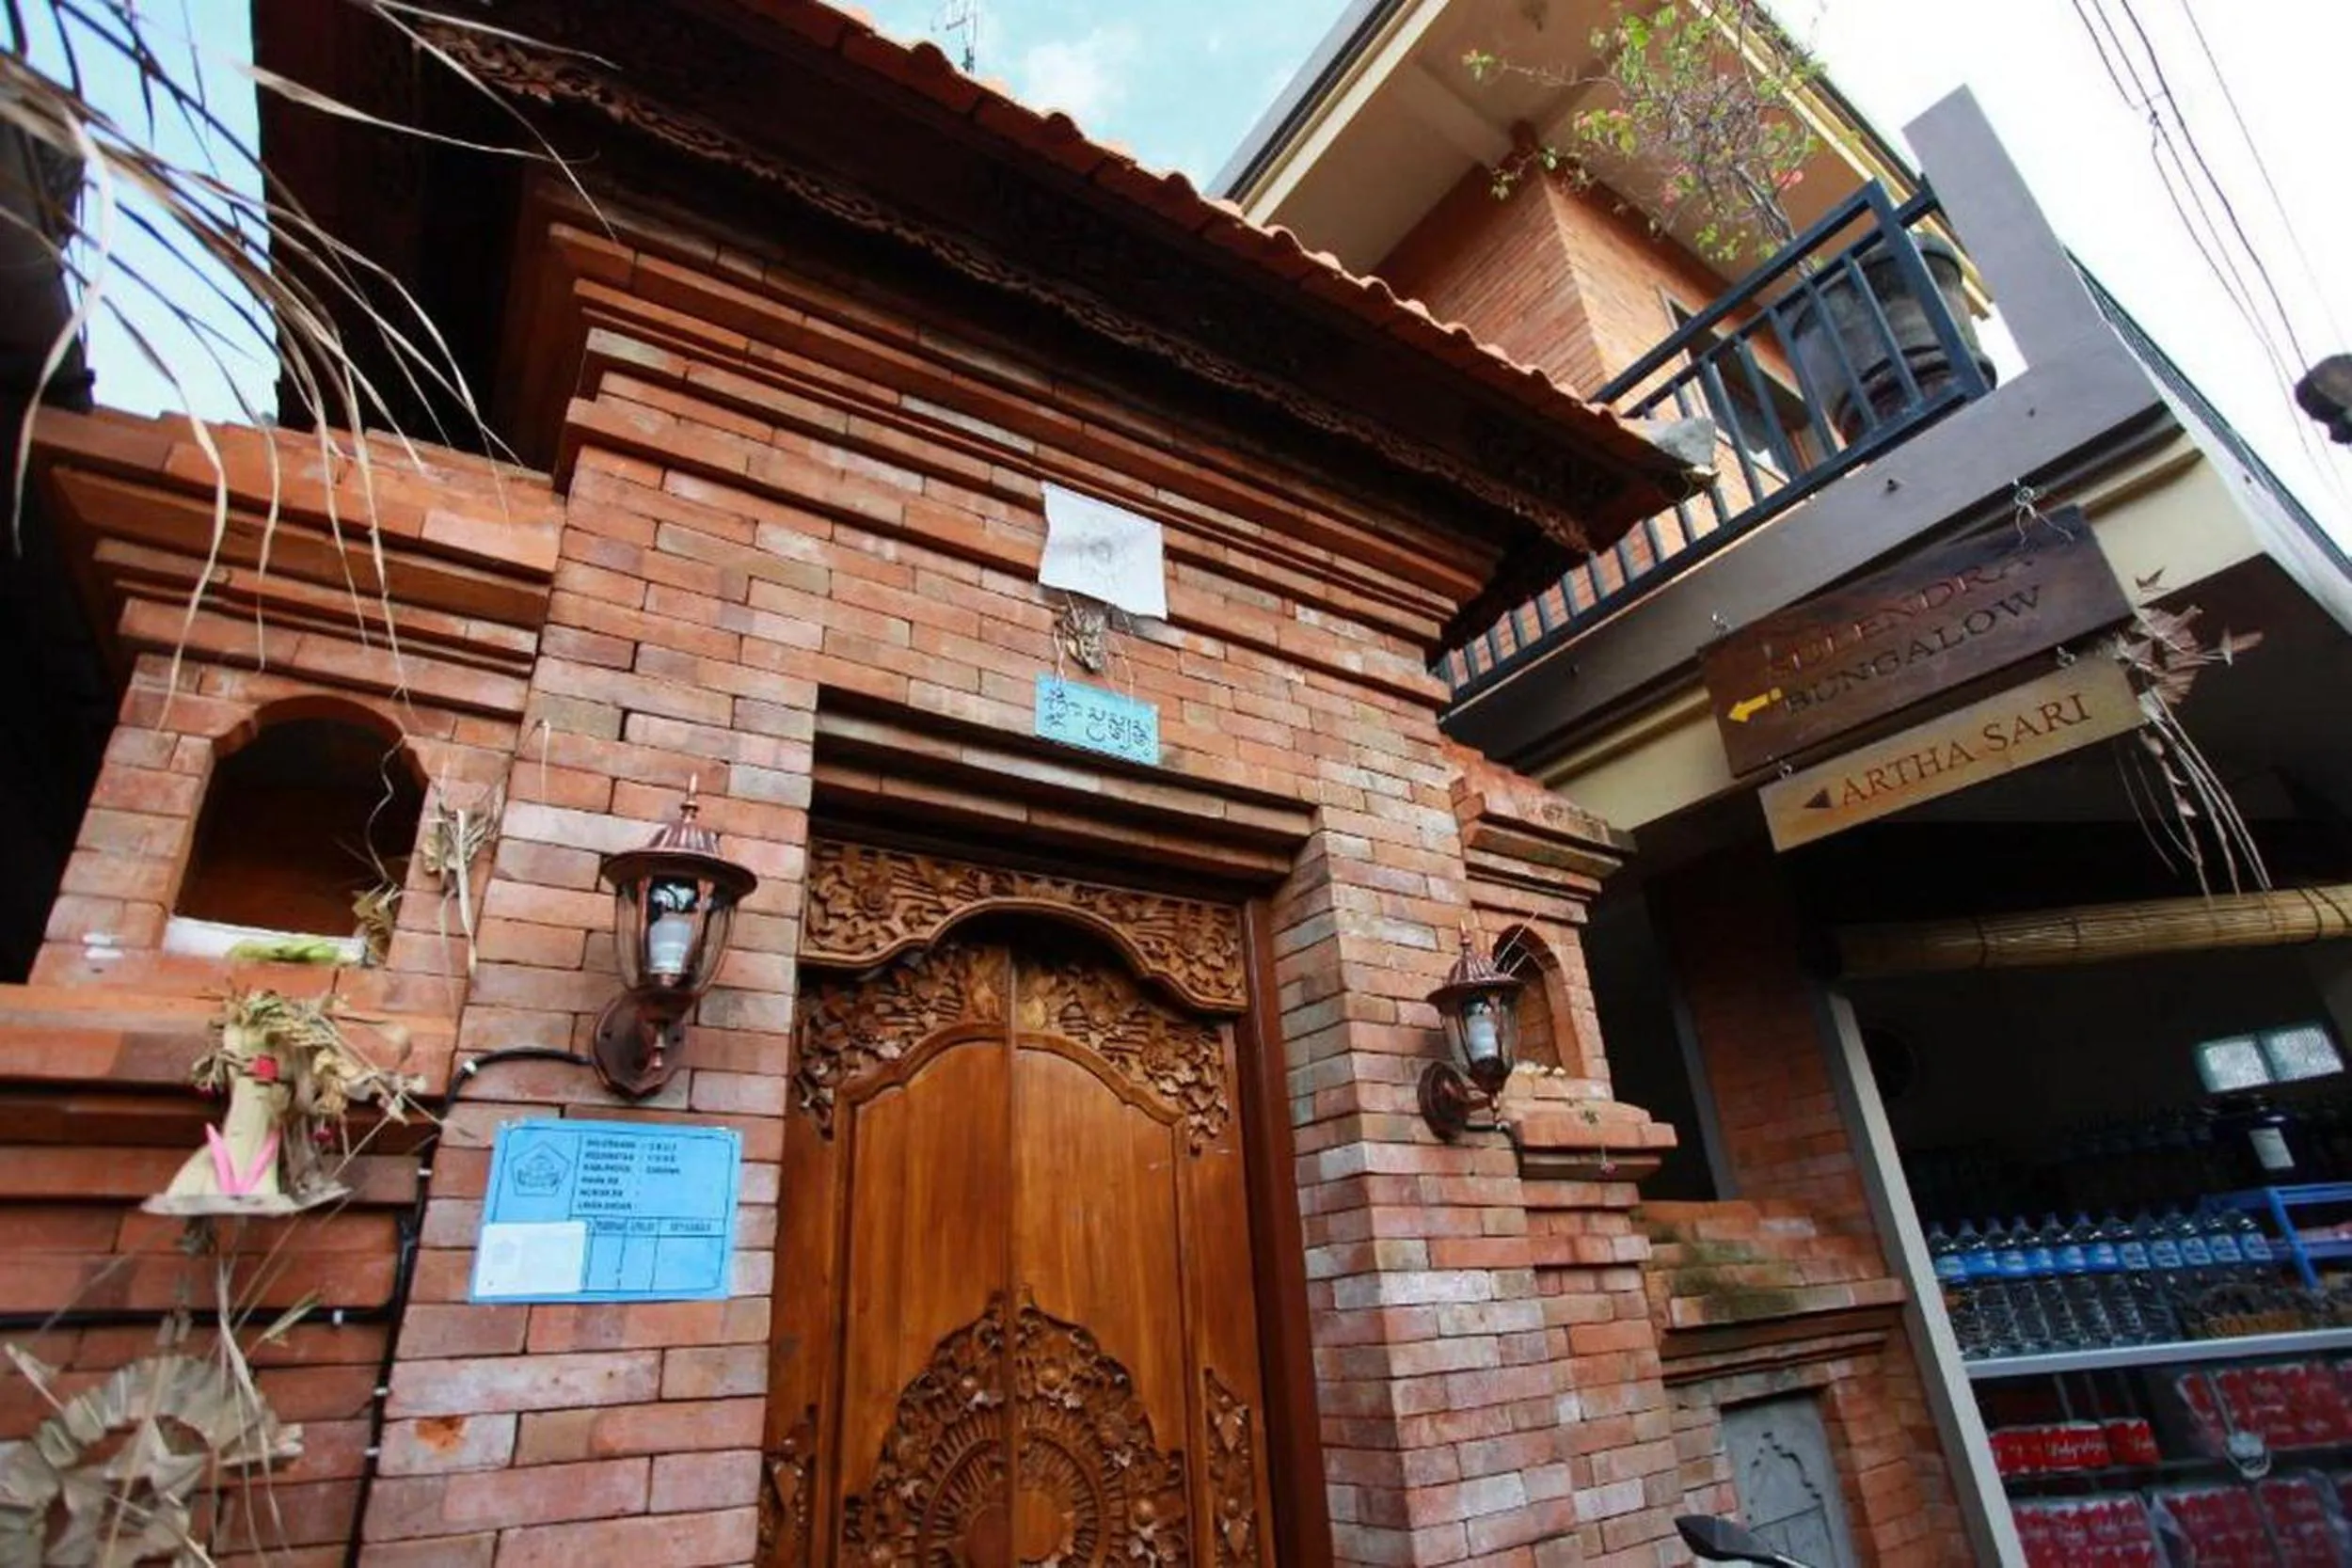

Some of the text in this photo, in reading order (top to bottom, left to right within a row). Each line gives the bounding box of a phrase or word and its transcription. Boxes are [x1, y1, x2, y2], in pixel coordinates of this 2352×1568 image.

[1787, 583, 2044, 717] BUNGALOW
[1842, 692, 2091, 806] ARTHA SARI
